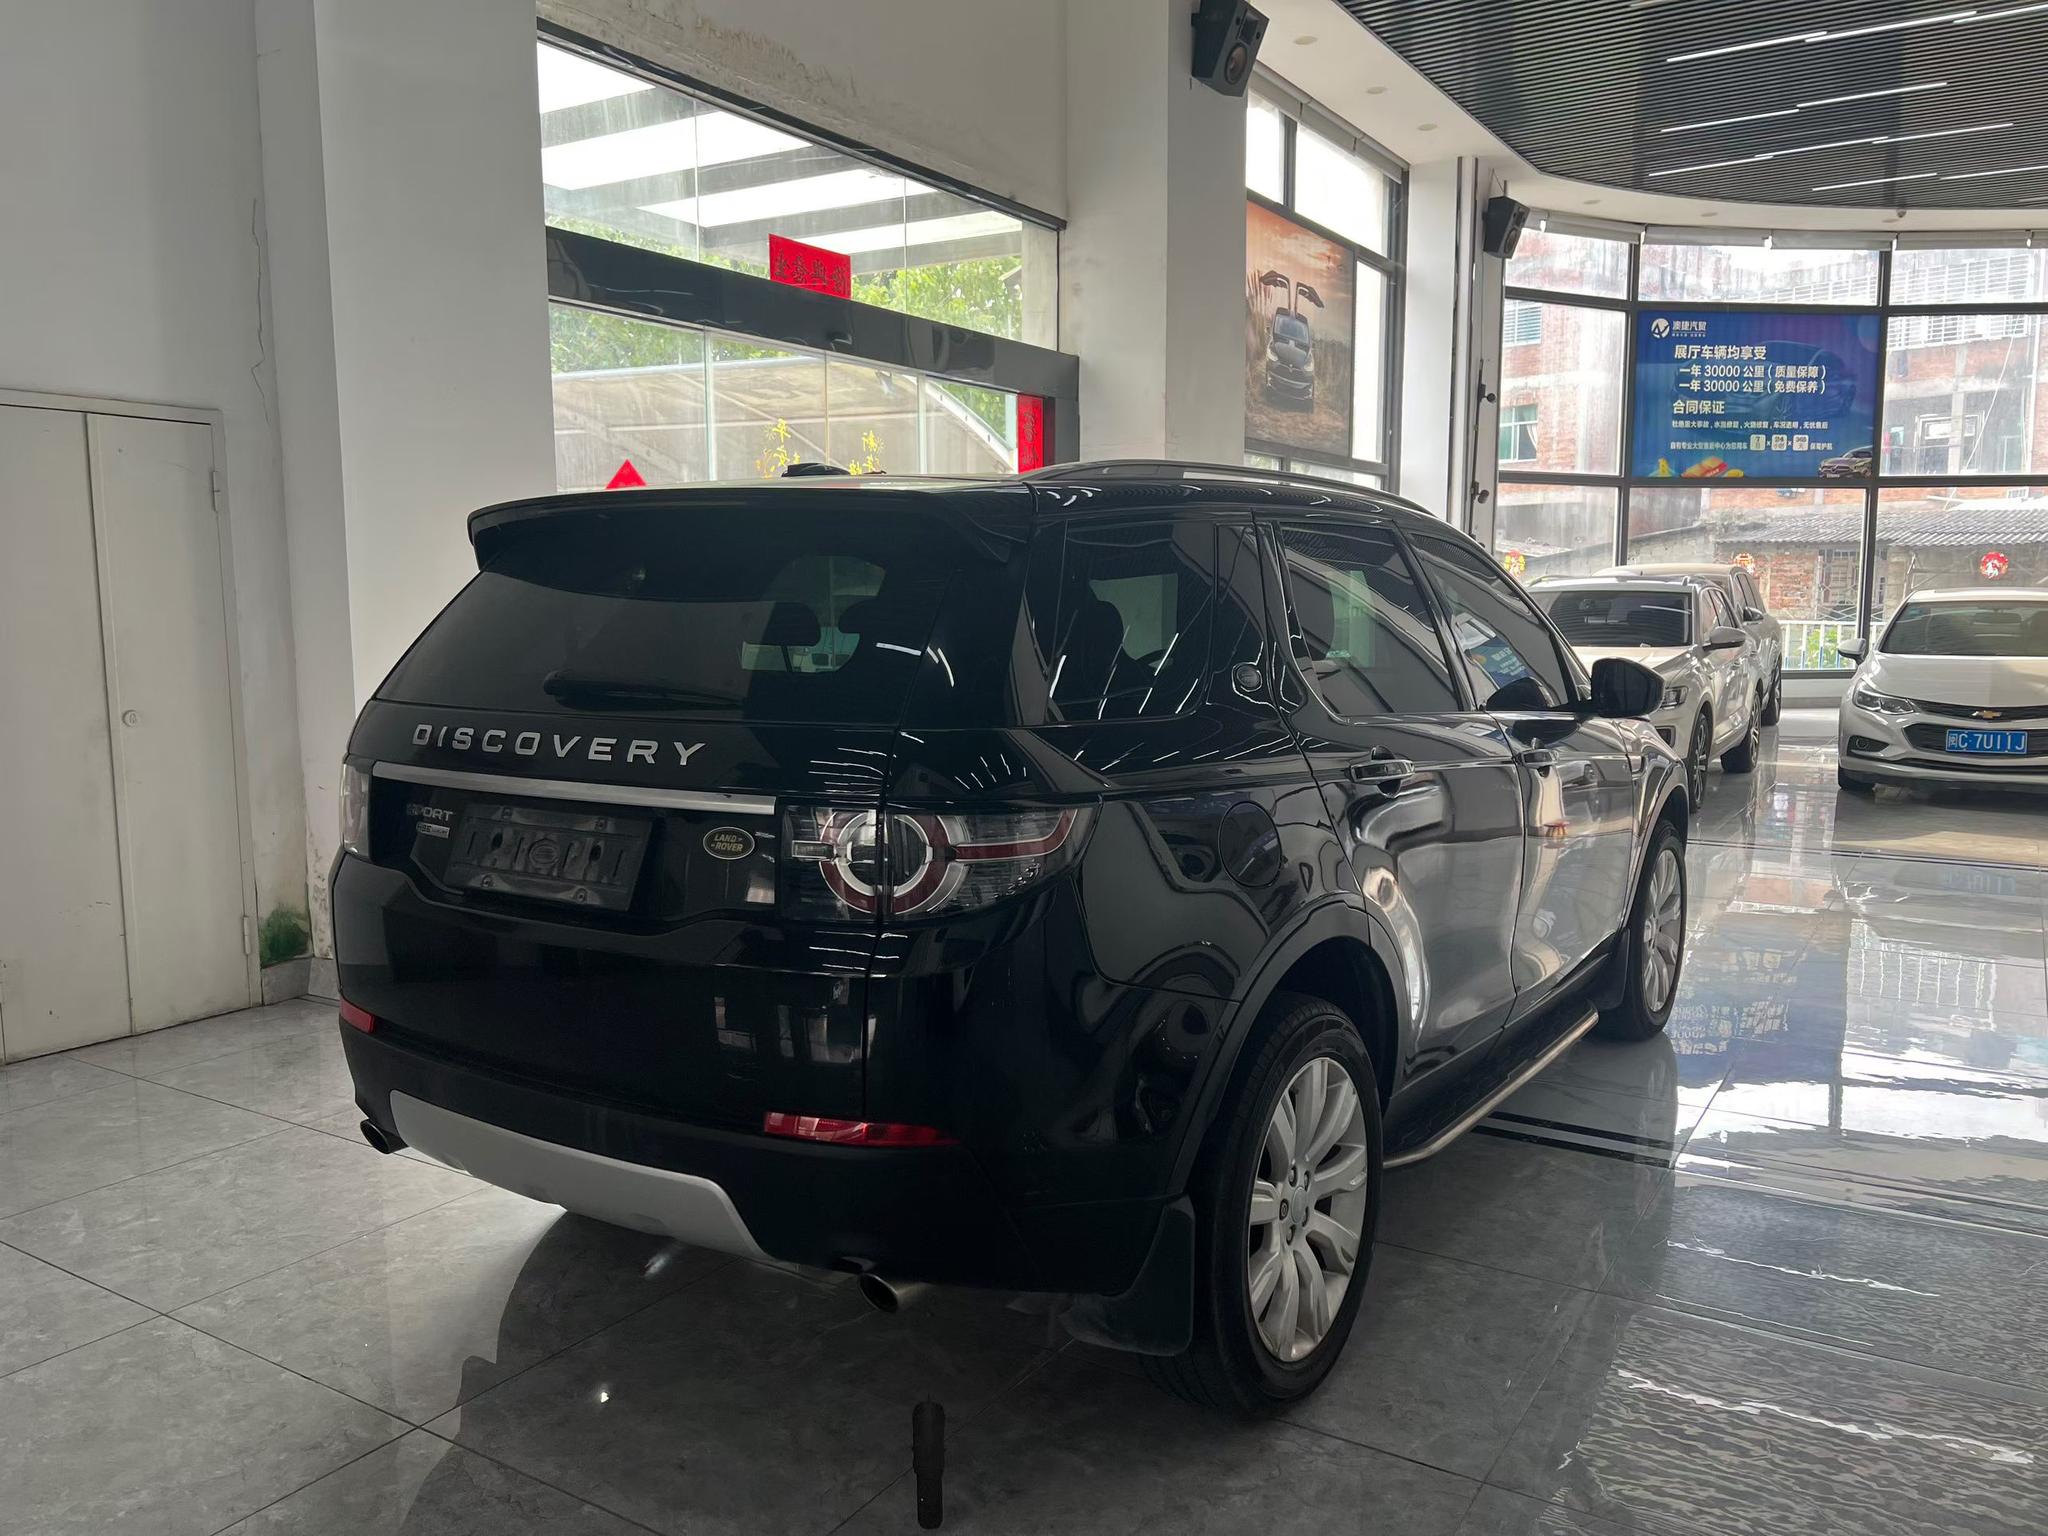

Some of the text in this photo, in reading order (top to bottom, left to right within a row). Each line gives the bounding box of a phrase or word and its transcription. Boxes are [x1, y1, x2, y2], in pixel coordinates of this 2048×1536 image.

[1674, 345, 1767, 360] 展厅车辆均享受
[1679, 364, 1701, 377] 一年
[1704, 365, 1740, 378] 30000
[1679, 380, 1701, 393] 一年
[1703, 380, 1740, 393] 30000
[1673, 400, 1725, 415] 合同保证
[412, 724, 706, 766] DISCOVERY
